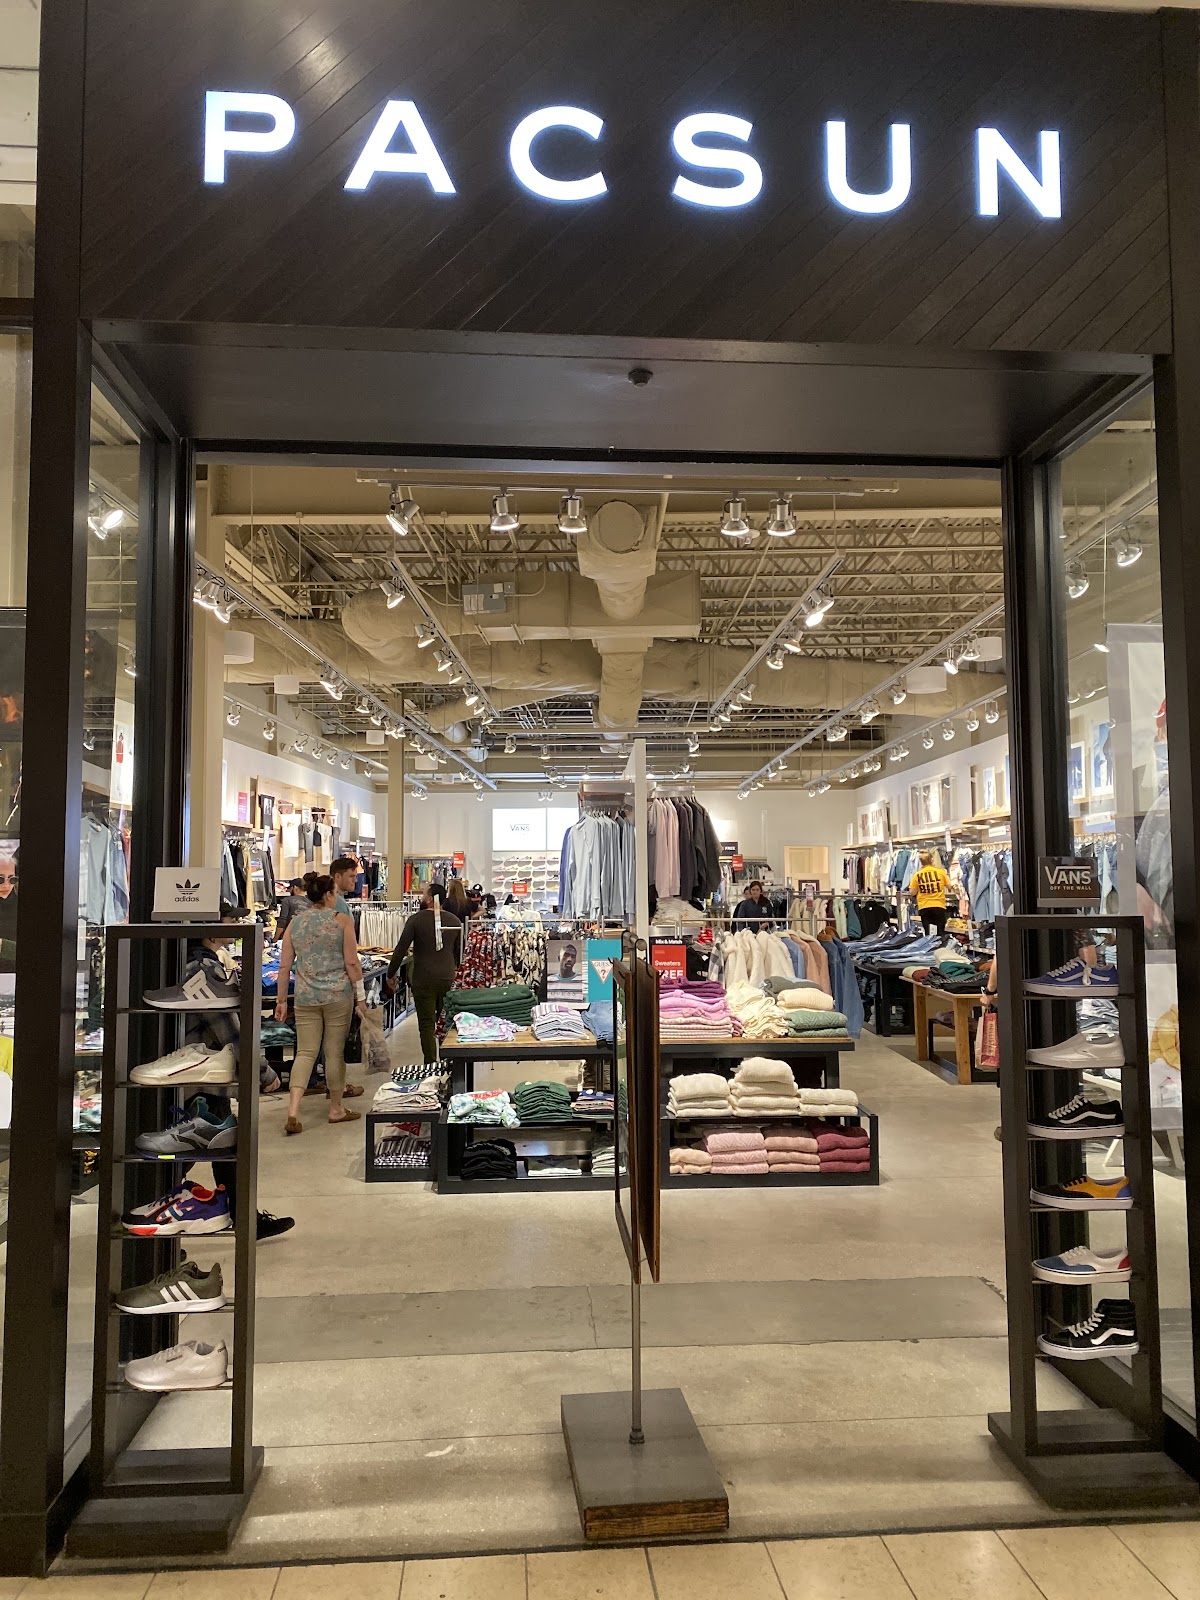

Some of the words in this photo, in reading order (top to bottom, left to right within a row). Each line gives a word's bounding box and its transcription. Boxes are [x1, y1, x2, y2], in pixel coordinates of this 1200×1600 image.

[203, 90, 1062, 219] PACSUN
[510, 823, 530, 831] VANS
[917, 871, 941, 884] KILL
[1044, 865, 1092, 885] VANS
[919, 883, 943, 894] BILL
